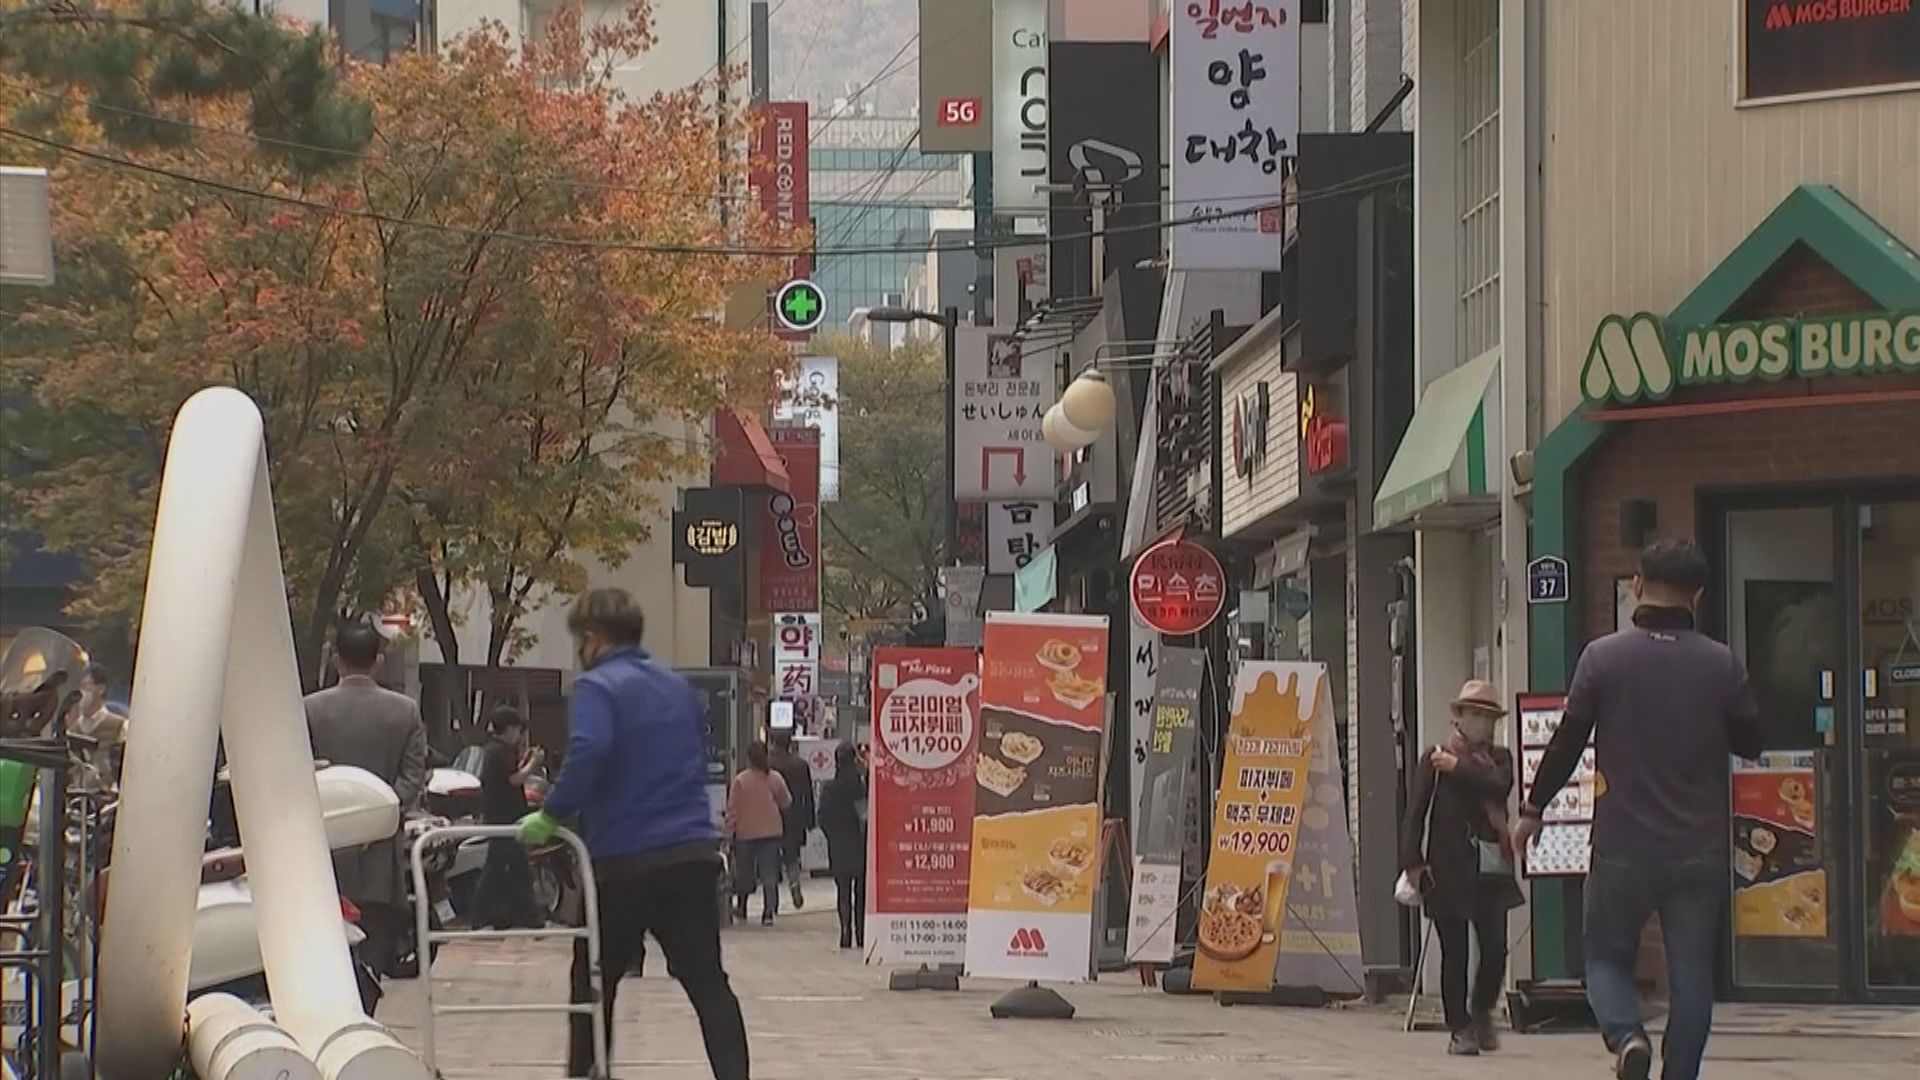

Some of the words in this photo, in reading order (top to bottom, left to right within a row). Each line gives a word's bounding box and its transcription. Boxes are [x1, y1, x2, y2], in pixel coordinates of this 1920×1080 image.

[1795, 4, 1838, 25] MOS
[1209, 49, 1266, 109] 양
[946, 101, 975, 123] 5G
[1185, 118, 1287, 174] 대창
[1682, 325, 1789, 379] MOS
[962, 401, 1045, 421] せいしゅん
[1539, 578, 1556, 596] 37
[780, 626, 814, 658] 약
[782, 664, 812, 694] 药
[889, 694, 963, 714] 프리미엄
[889, 715, 963, 734] 피자뷔페
[1256, 805, 1296, 825] 무제한
